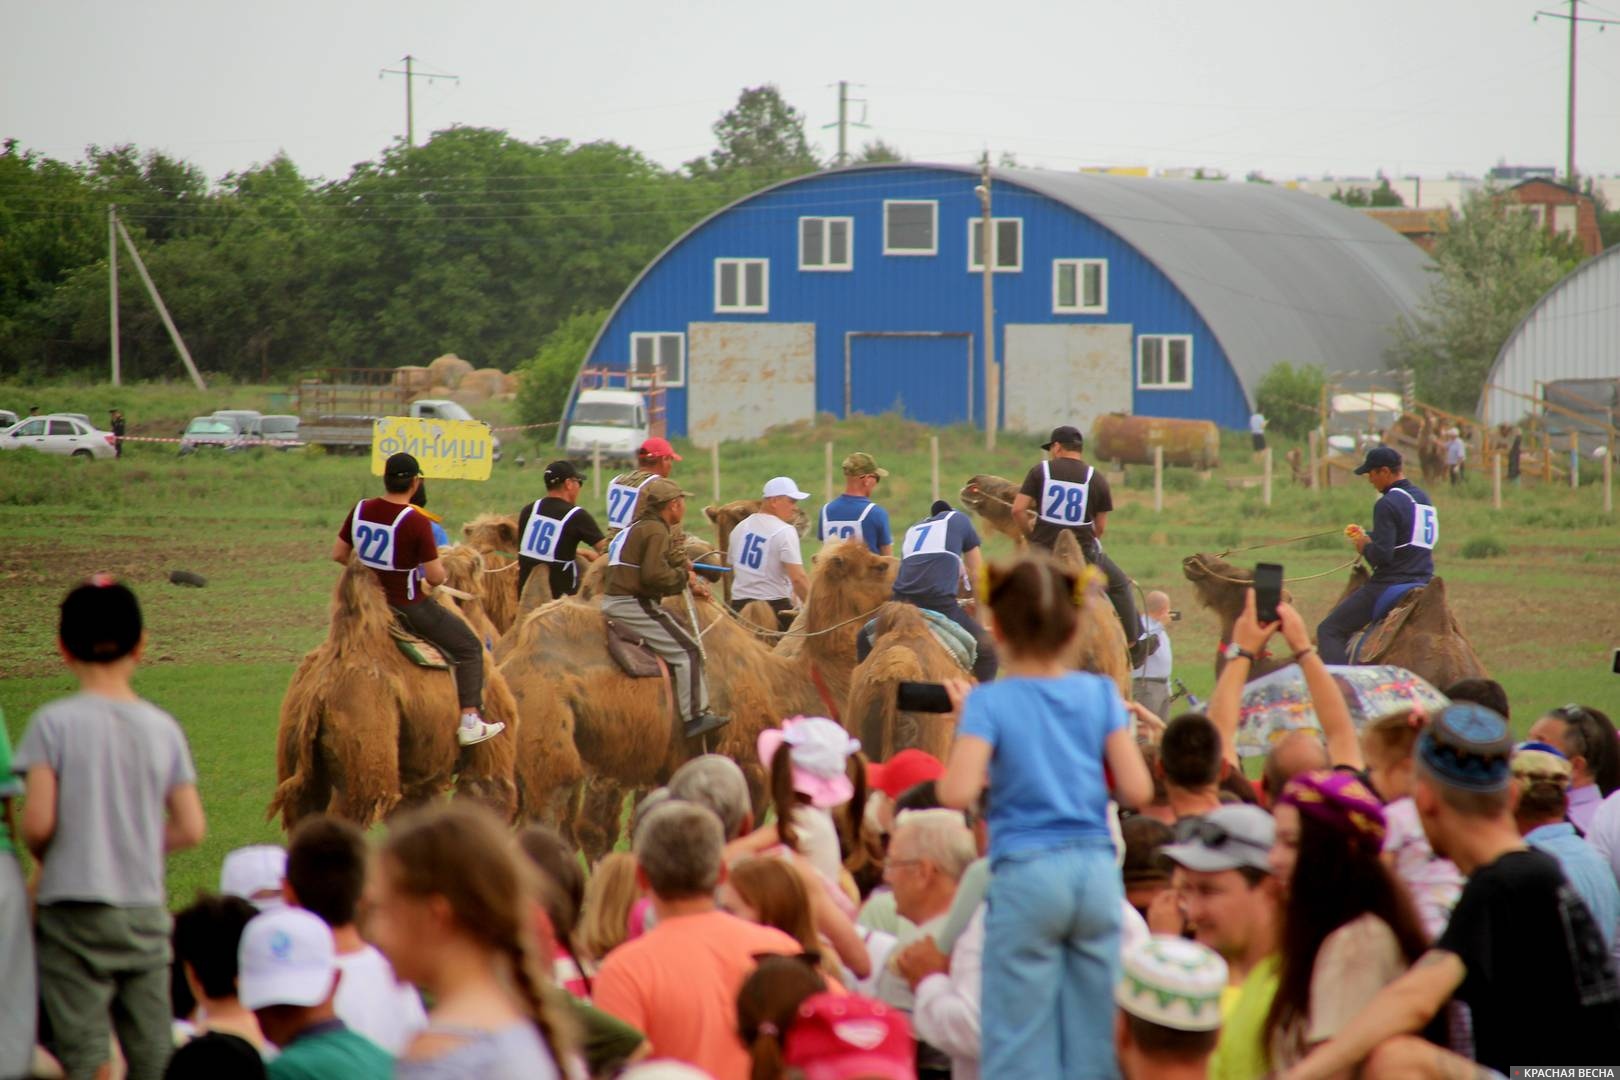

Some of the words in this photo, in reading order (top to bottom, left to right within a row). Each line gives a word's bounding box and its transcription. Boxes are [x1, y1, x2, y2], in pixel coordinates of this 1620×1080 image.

[379, 437, 485, 460] ФИНИШ
[608, 487, 637, 523] 27
[1046, 484, 1083, 522] 28
[357, 525, 389, 565] 22
[527, 519, 556, 555] 16
[913, 525, 933, 552] 7
[1424, 509, 1434, 545] 5
[740, 532, 767, 570] 15
